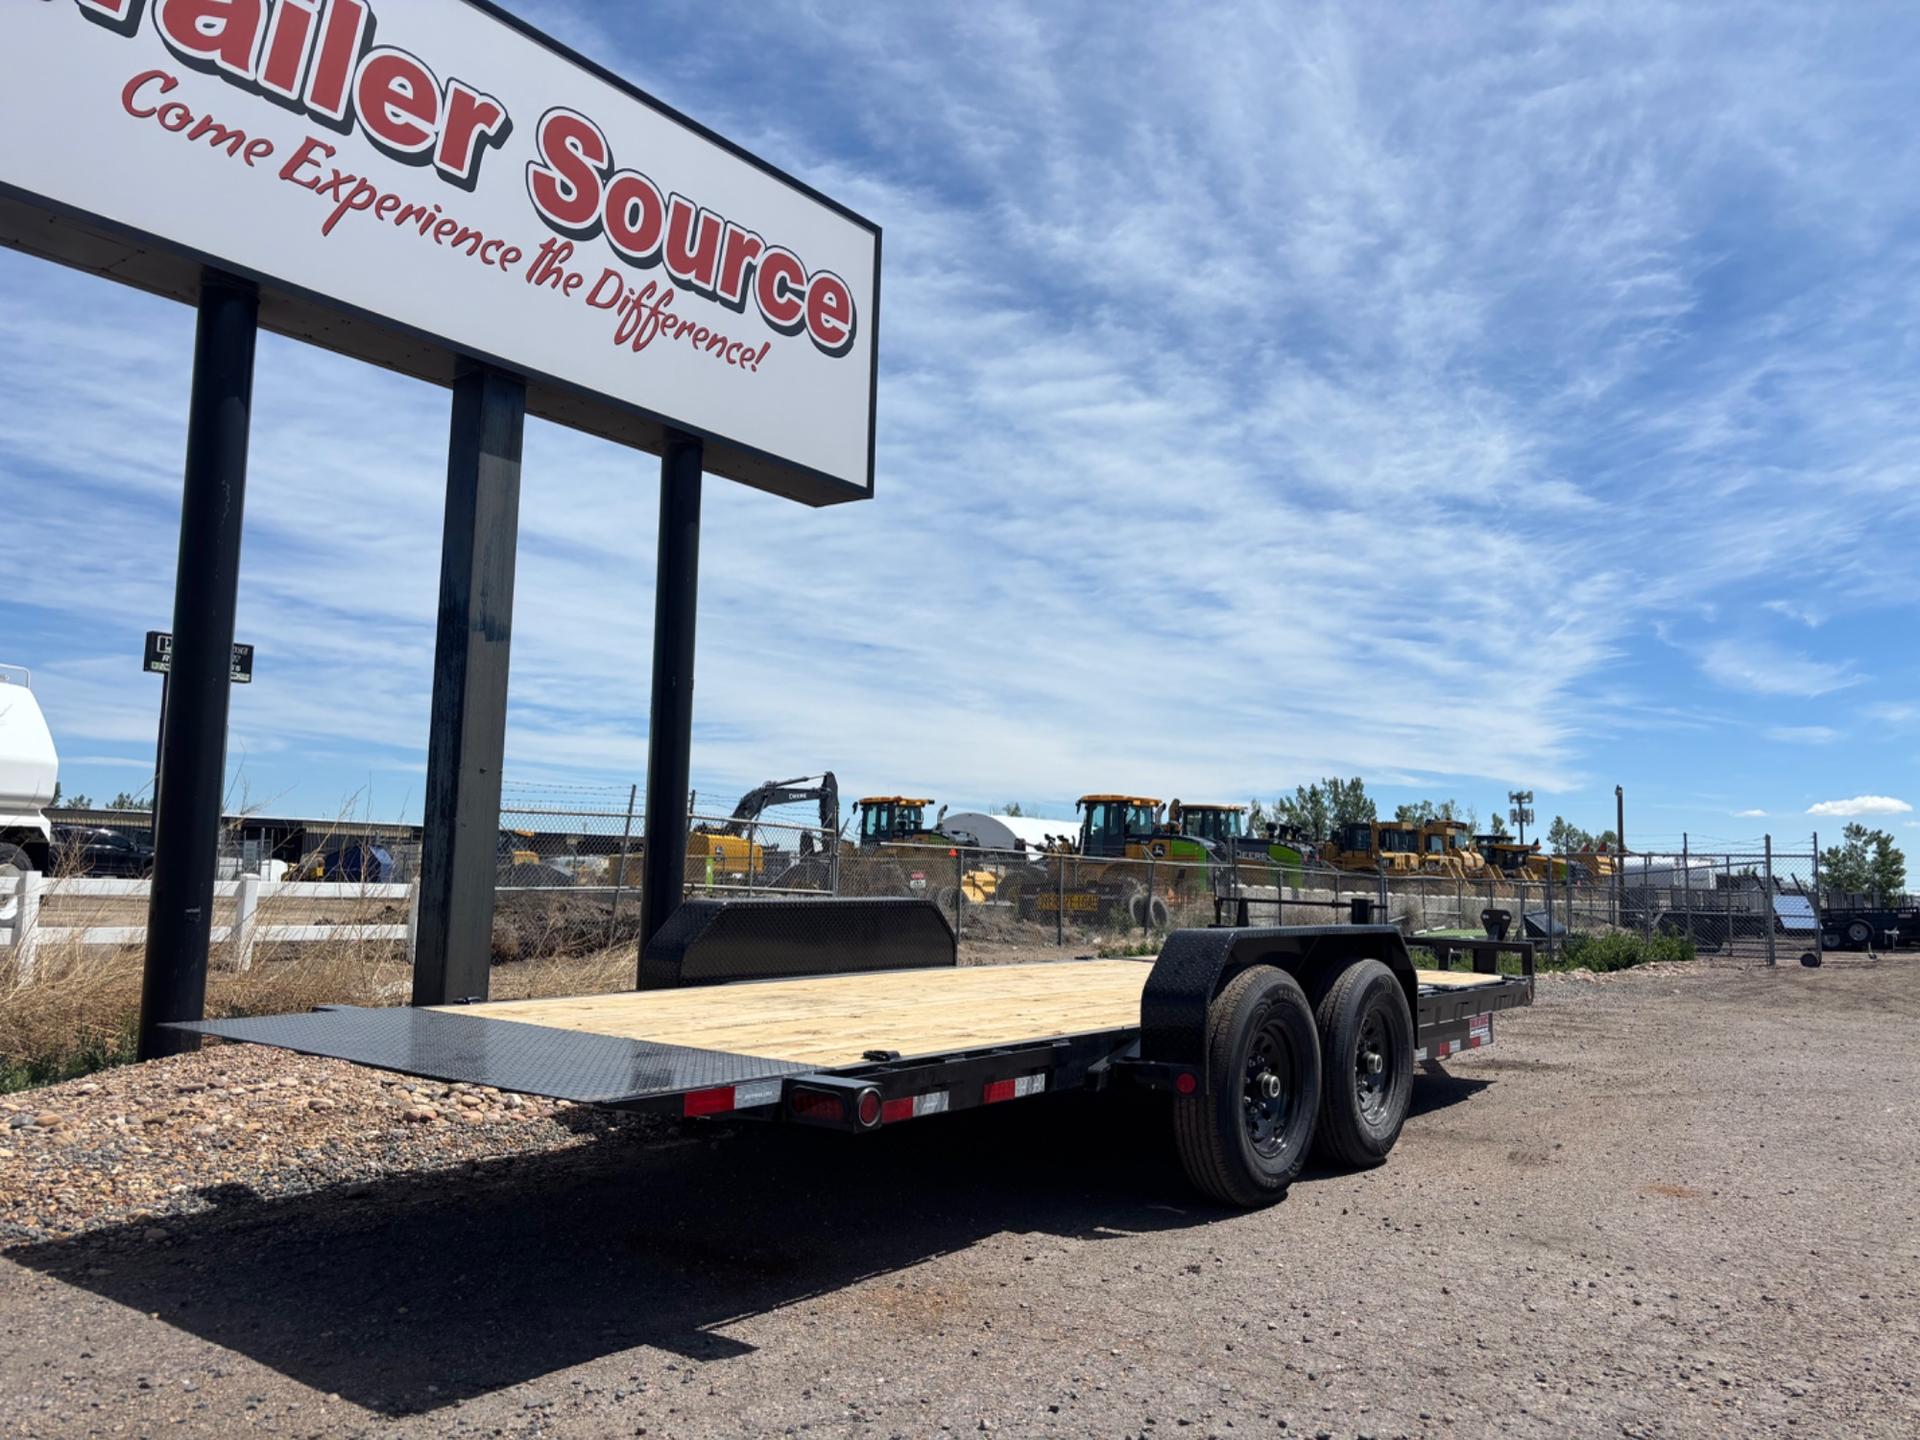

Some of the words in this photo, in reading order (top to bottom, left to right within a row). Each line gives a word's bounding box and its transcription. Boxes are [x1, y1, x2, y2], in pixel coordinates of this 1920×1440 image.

[75, 0, 512, 192] ailer
[525, 106, 857, 358] Source
[121, 69, 274, 166] Come
[279, 135, 522, 273] Experience
[525, 237, 583, 297] the
[585, 267, 771, 373] Difference!
